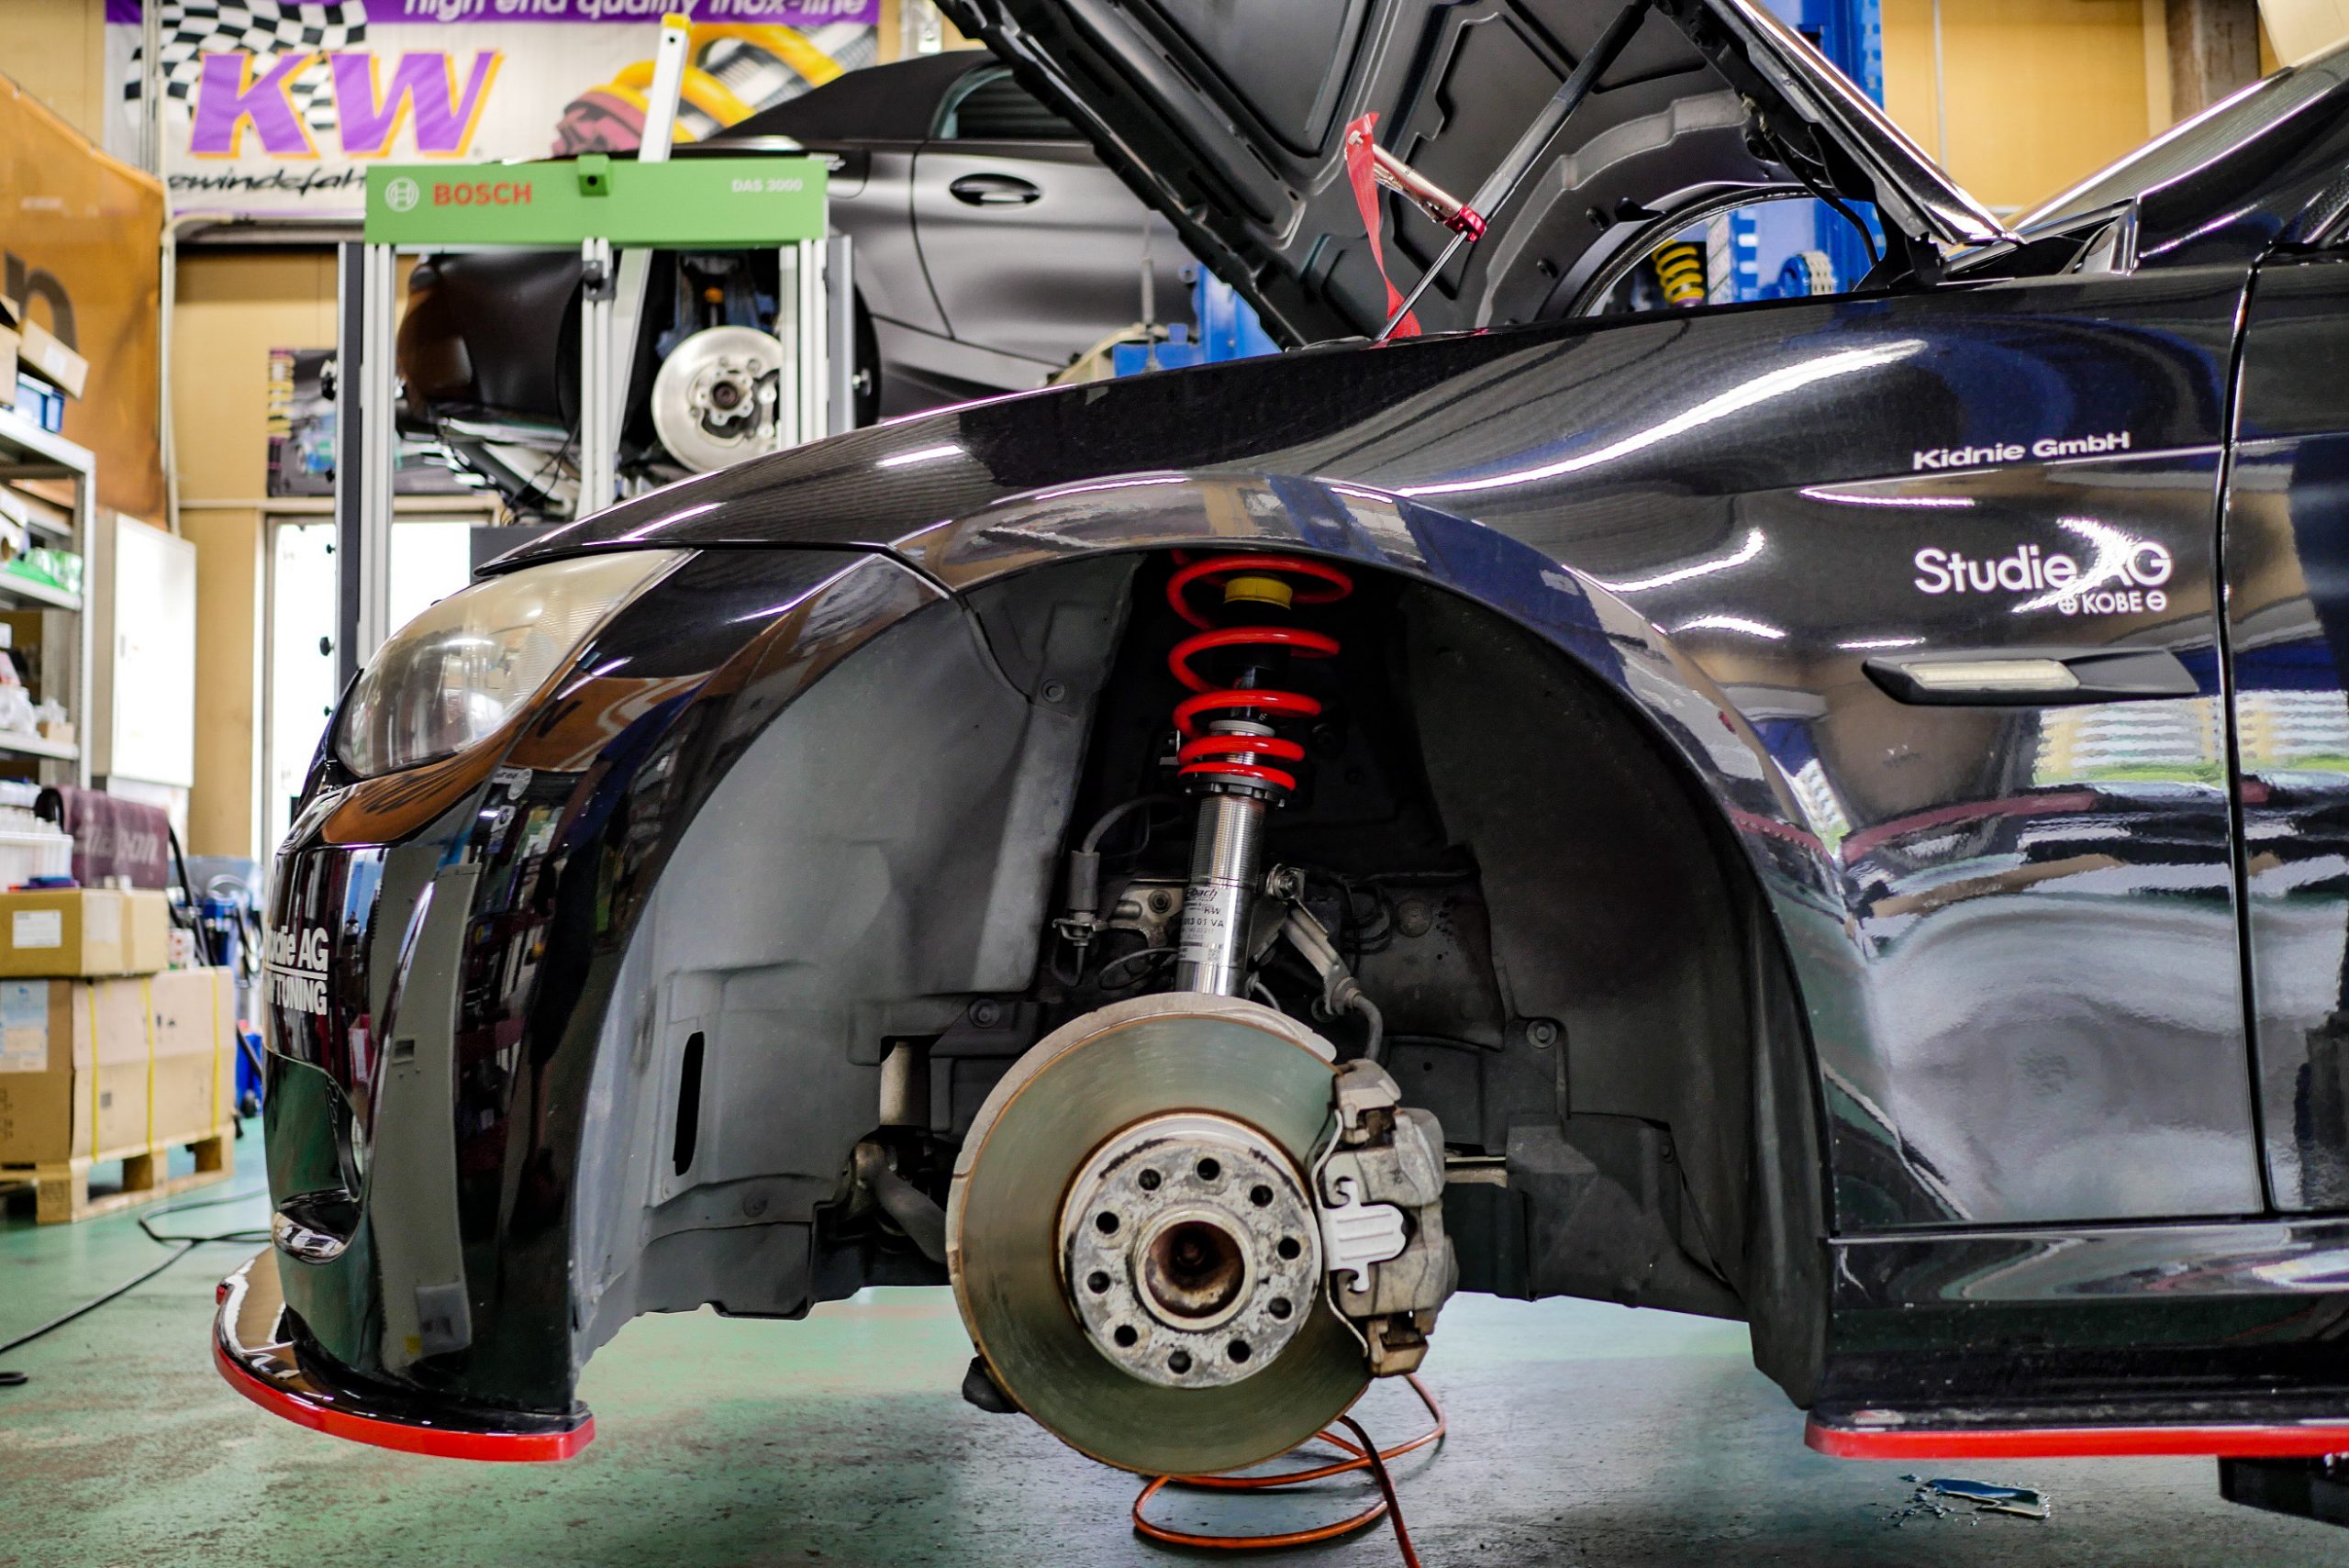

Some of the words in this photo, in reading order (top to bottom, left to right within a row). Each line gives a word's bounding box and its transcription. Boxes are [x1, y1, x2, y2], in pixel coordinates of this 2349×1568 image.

[186, 50, 505, 159] KW
[433, 182, 532, 206] BOSCH
[731, 178, 763, 192] DAS
[766, 178, 804, 192] 3000
[1913, 442, 2026, 470] Kidnie
[2032, 431, 2131, 457] GmbH
[1913, 544, 2078, 594] Studie
[2082, 592, 2143, 614] KOBE
[297, 927, 328, 972] AG
[275, 973, 328, 1016] TUNING
